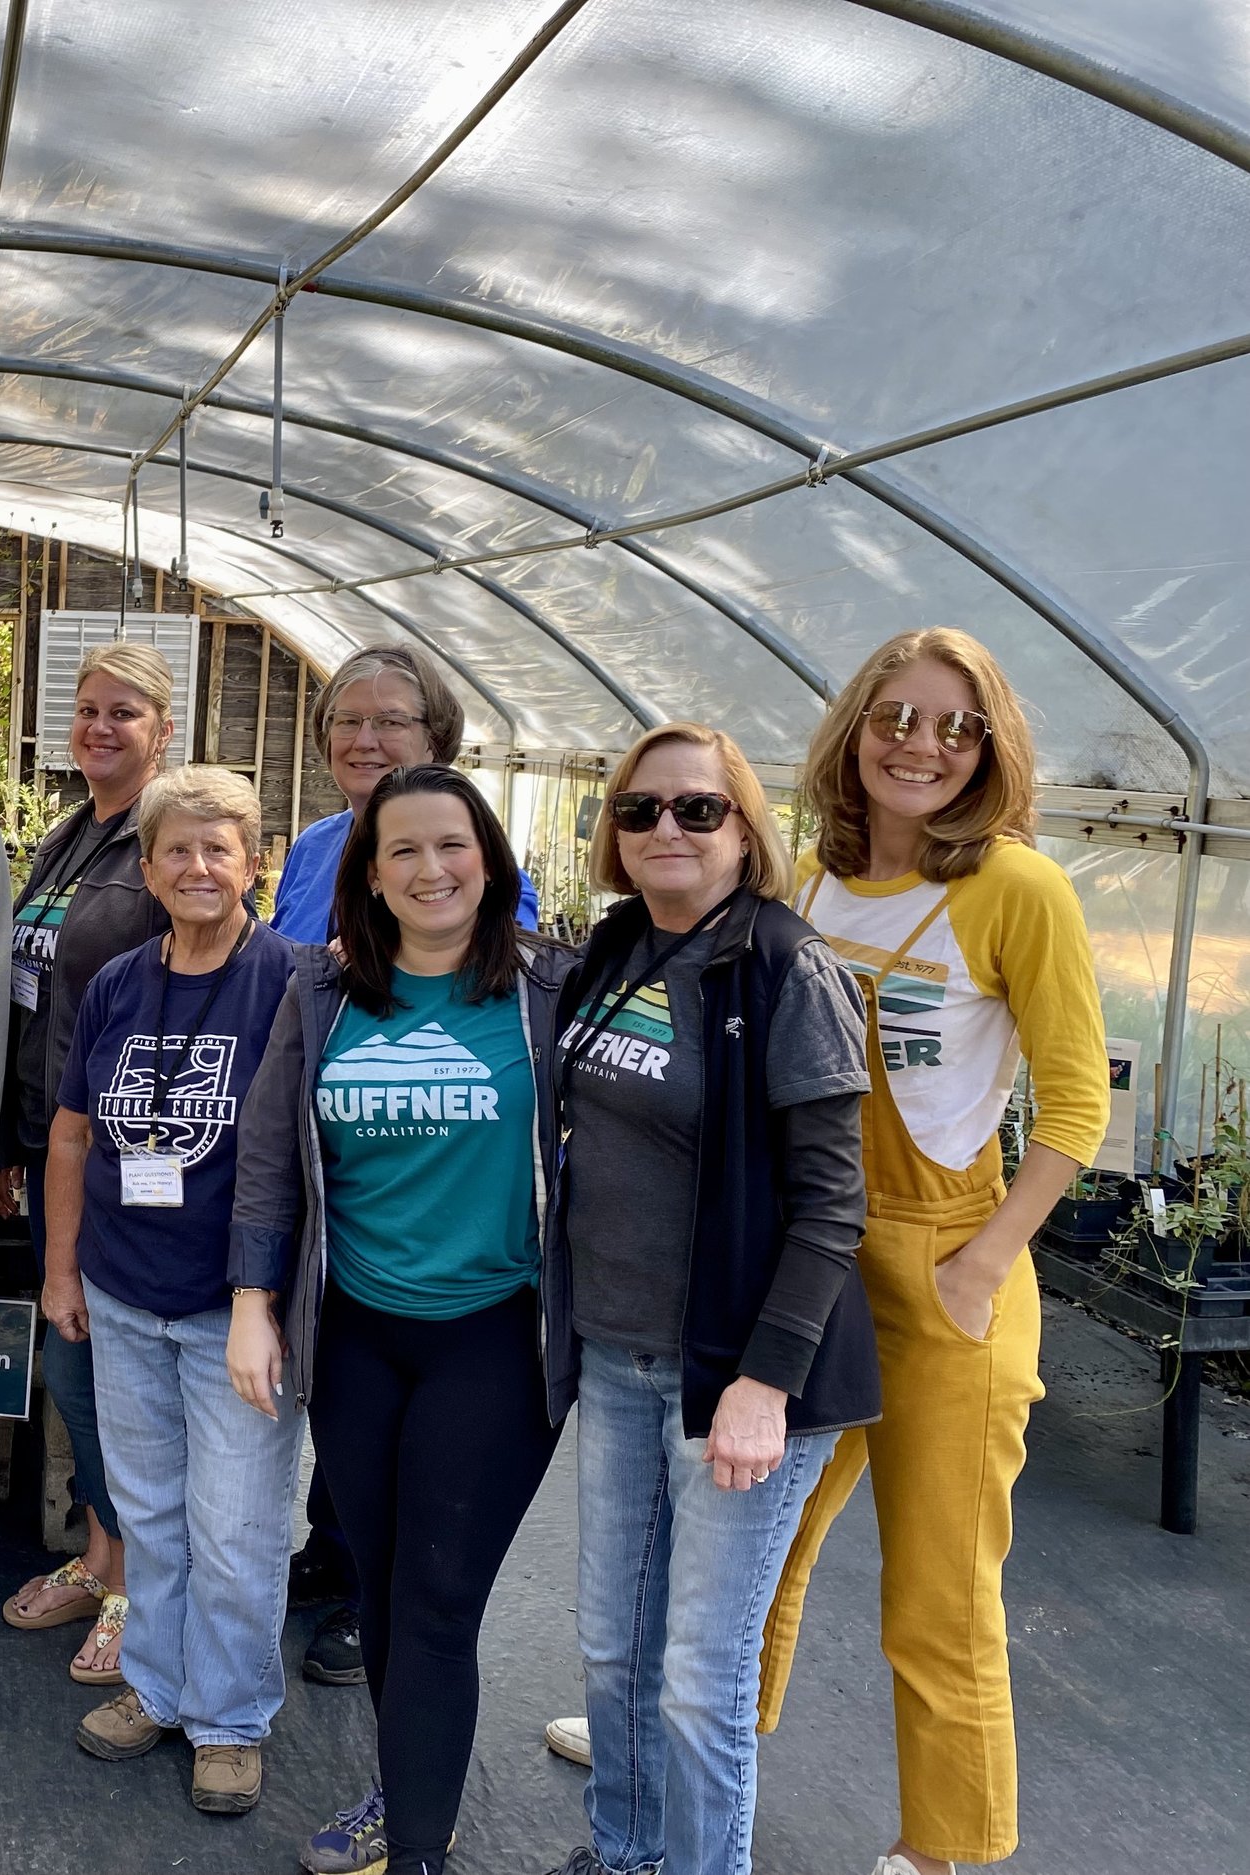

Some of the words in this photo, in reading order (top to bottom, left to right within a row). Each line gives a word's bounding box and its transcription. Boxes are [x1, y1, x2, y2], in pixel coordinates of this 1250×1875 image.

[914, 963, 937, 975] 1977
[633, 1021, 646, 1031] EST.
[647, 1025, 668, 1037] 1977
[133, 1038, 170, 1048] PINSN,
[434, 1067, 453, 1075] EST.
[456, 1066, 482, 1075] 1977
[105, 1098, 153, 1117] TURKE
[172, 1099, 227, 1119] CREEK
[316, 1085, 501, 1123] RUFFNER
[355, 1126, 450, 1138] COALITION
